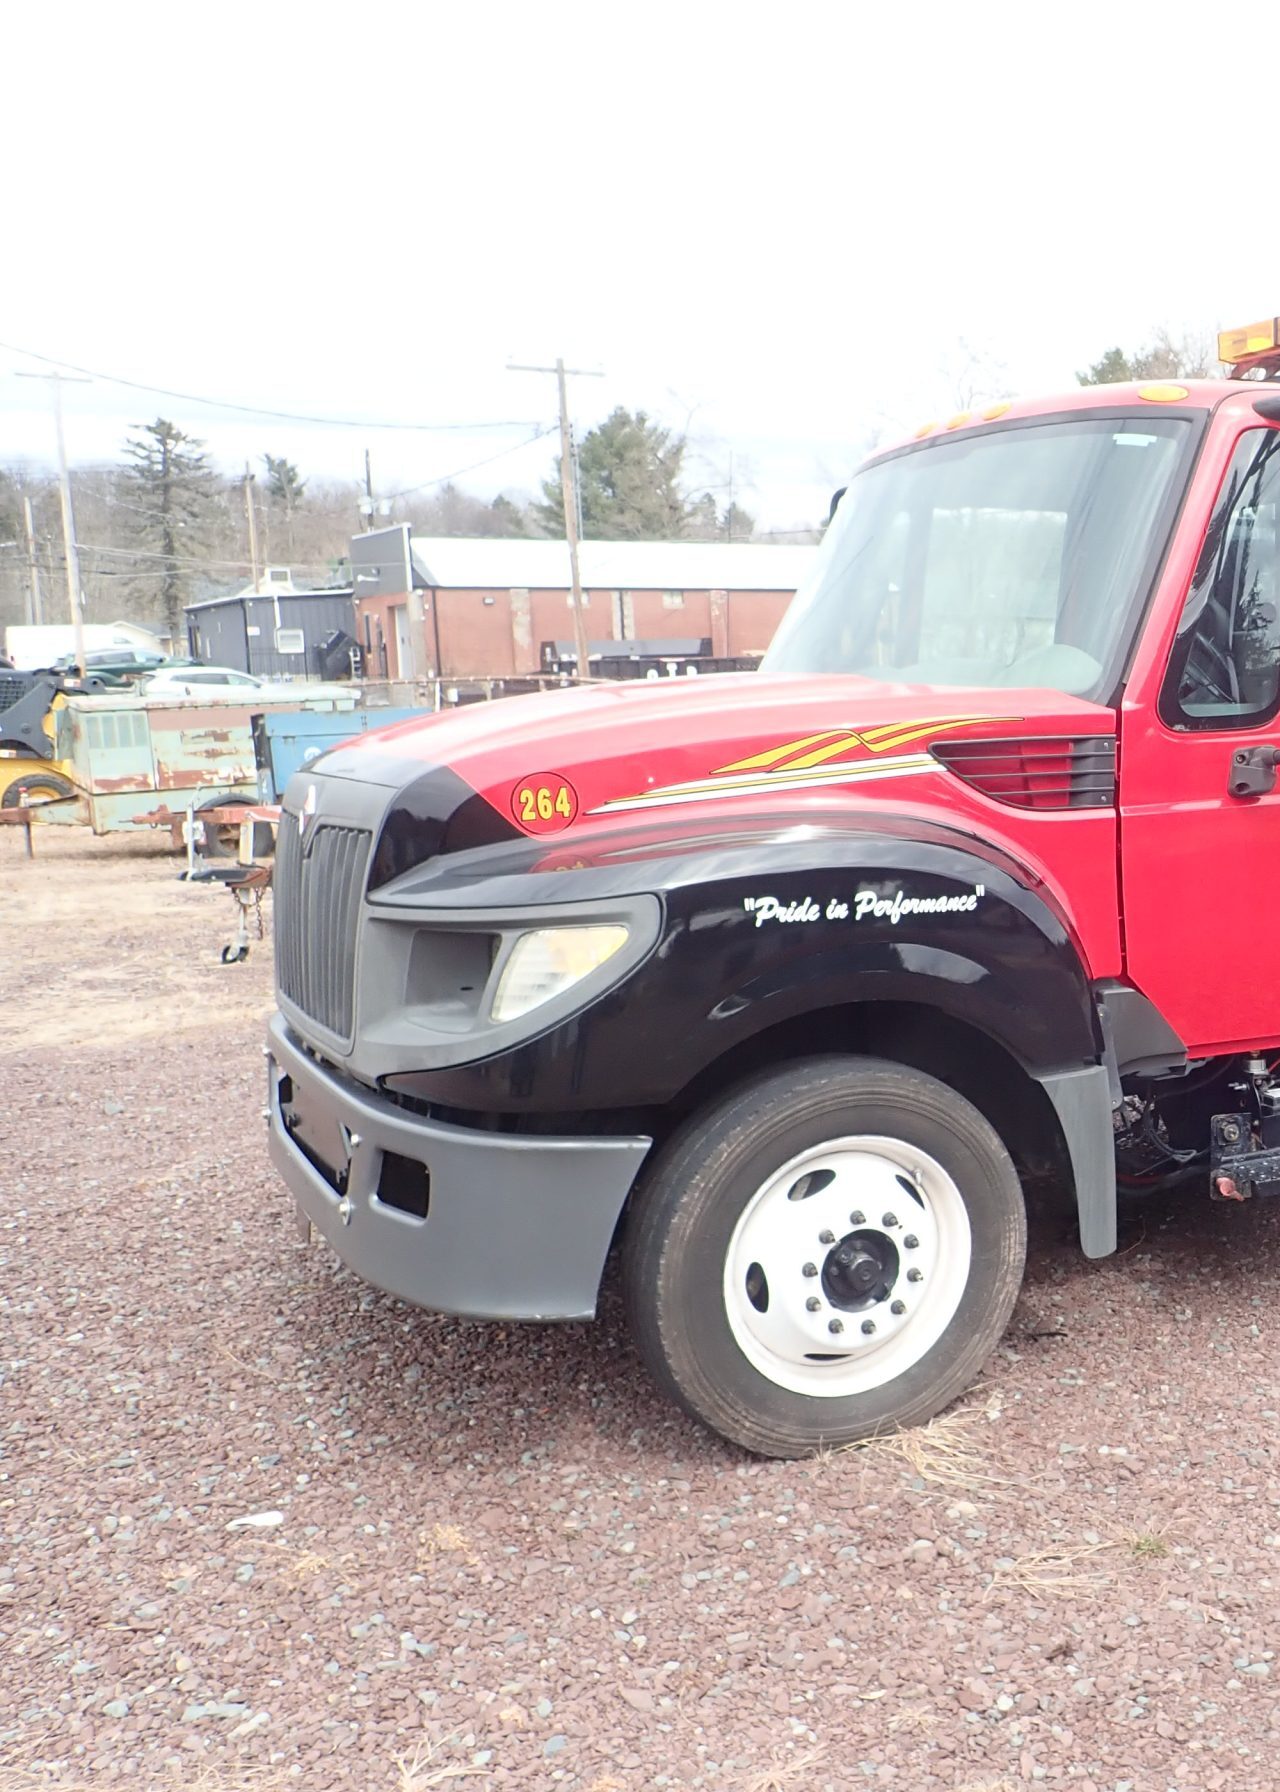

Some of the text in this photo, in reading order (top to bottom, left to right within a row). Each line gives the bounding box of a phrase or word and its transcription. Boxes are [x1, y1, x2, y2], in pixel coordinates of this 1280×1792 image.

[519, 786, 571, 821] 264
[744, 884, 985, 928] "Pride in Performance"
